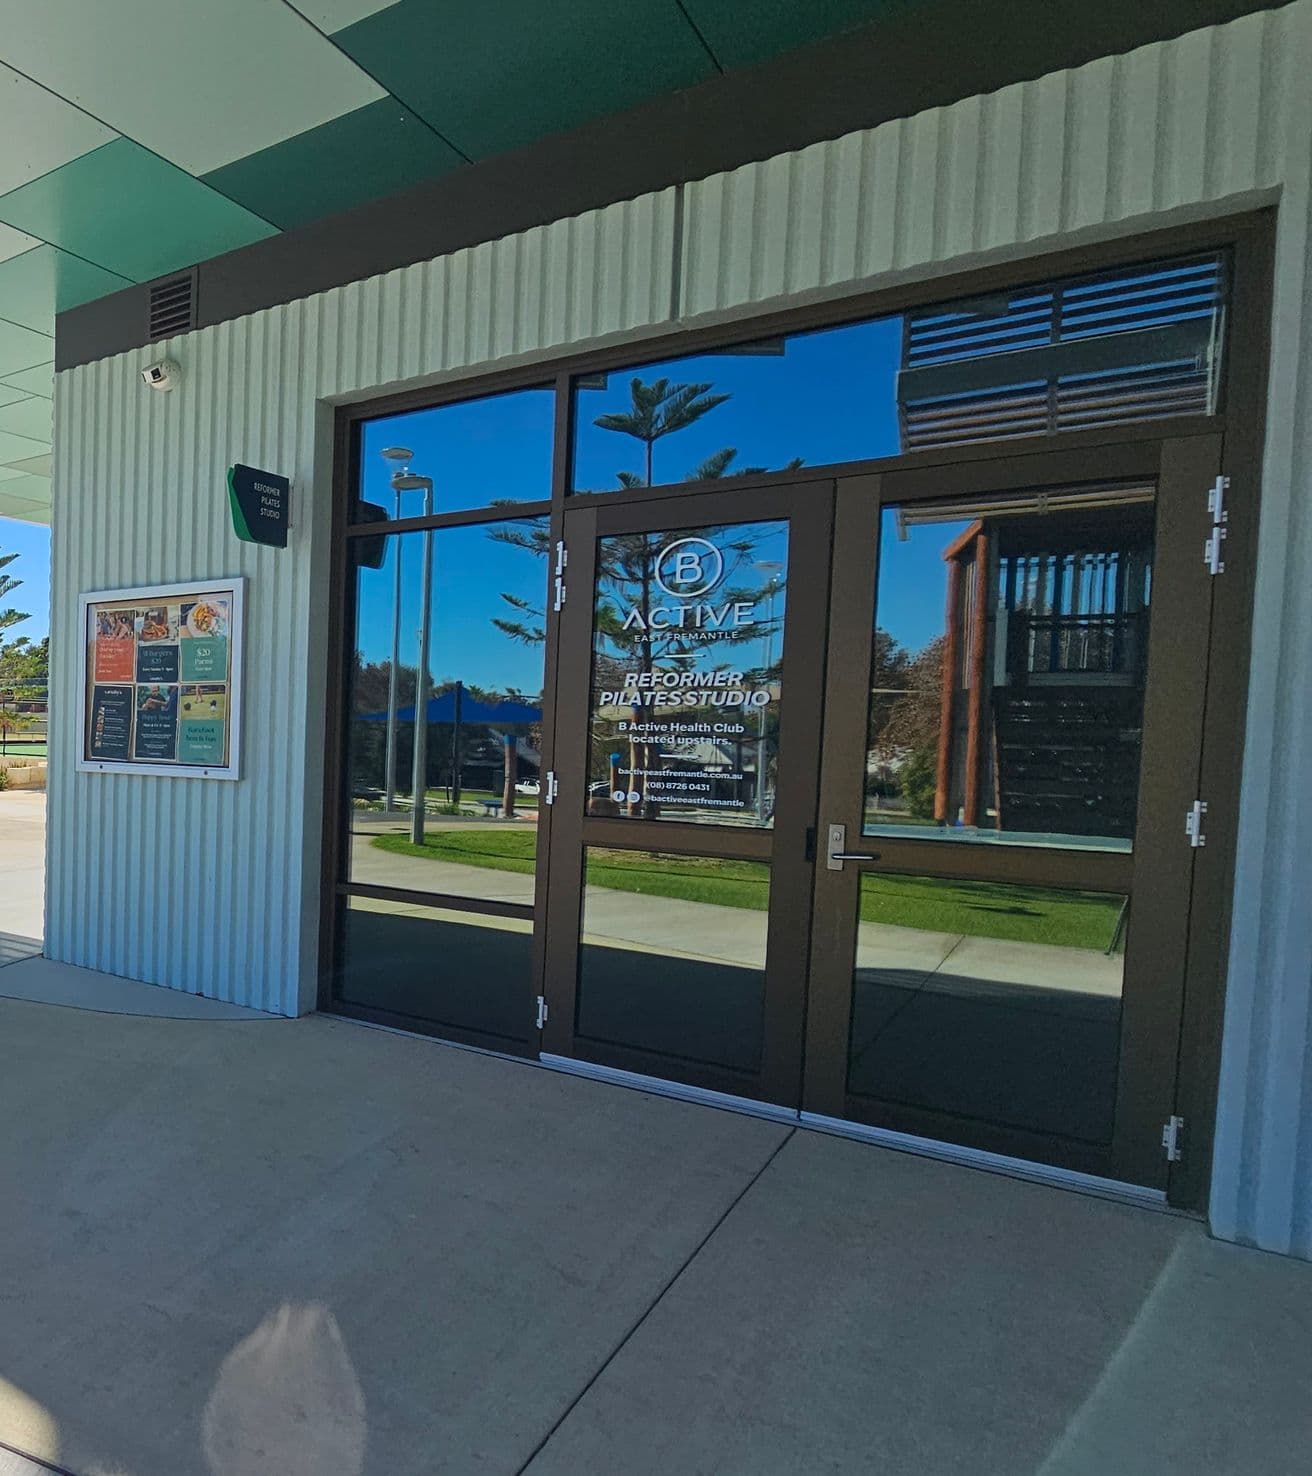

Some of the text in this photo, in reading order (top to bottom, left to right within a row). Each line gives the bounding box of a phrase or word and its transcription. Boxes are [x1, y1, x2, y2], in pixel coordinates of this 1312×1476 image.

[253, 482, 280, 496] REFORMER
[261, 497, 280, 508] PILATES
[260, 508, 280, 519] STUDIO
[676, 552, 702, 583] B
[622, 602, 754, 630] ACTIVE
[634, 631, 739, 642] EAST FREMANTLE
[624, 672, 744, 688] REFORMER
[618, 722, 745, 733] B Active Health Club
[629, 734, 732, 747] located upstairs.
[618, 768, 743, 780] bactiveeastfremantle.com.au
[647, 781, 710, 792] (08) 8726 0431
